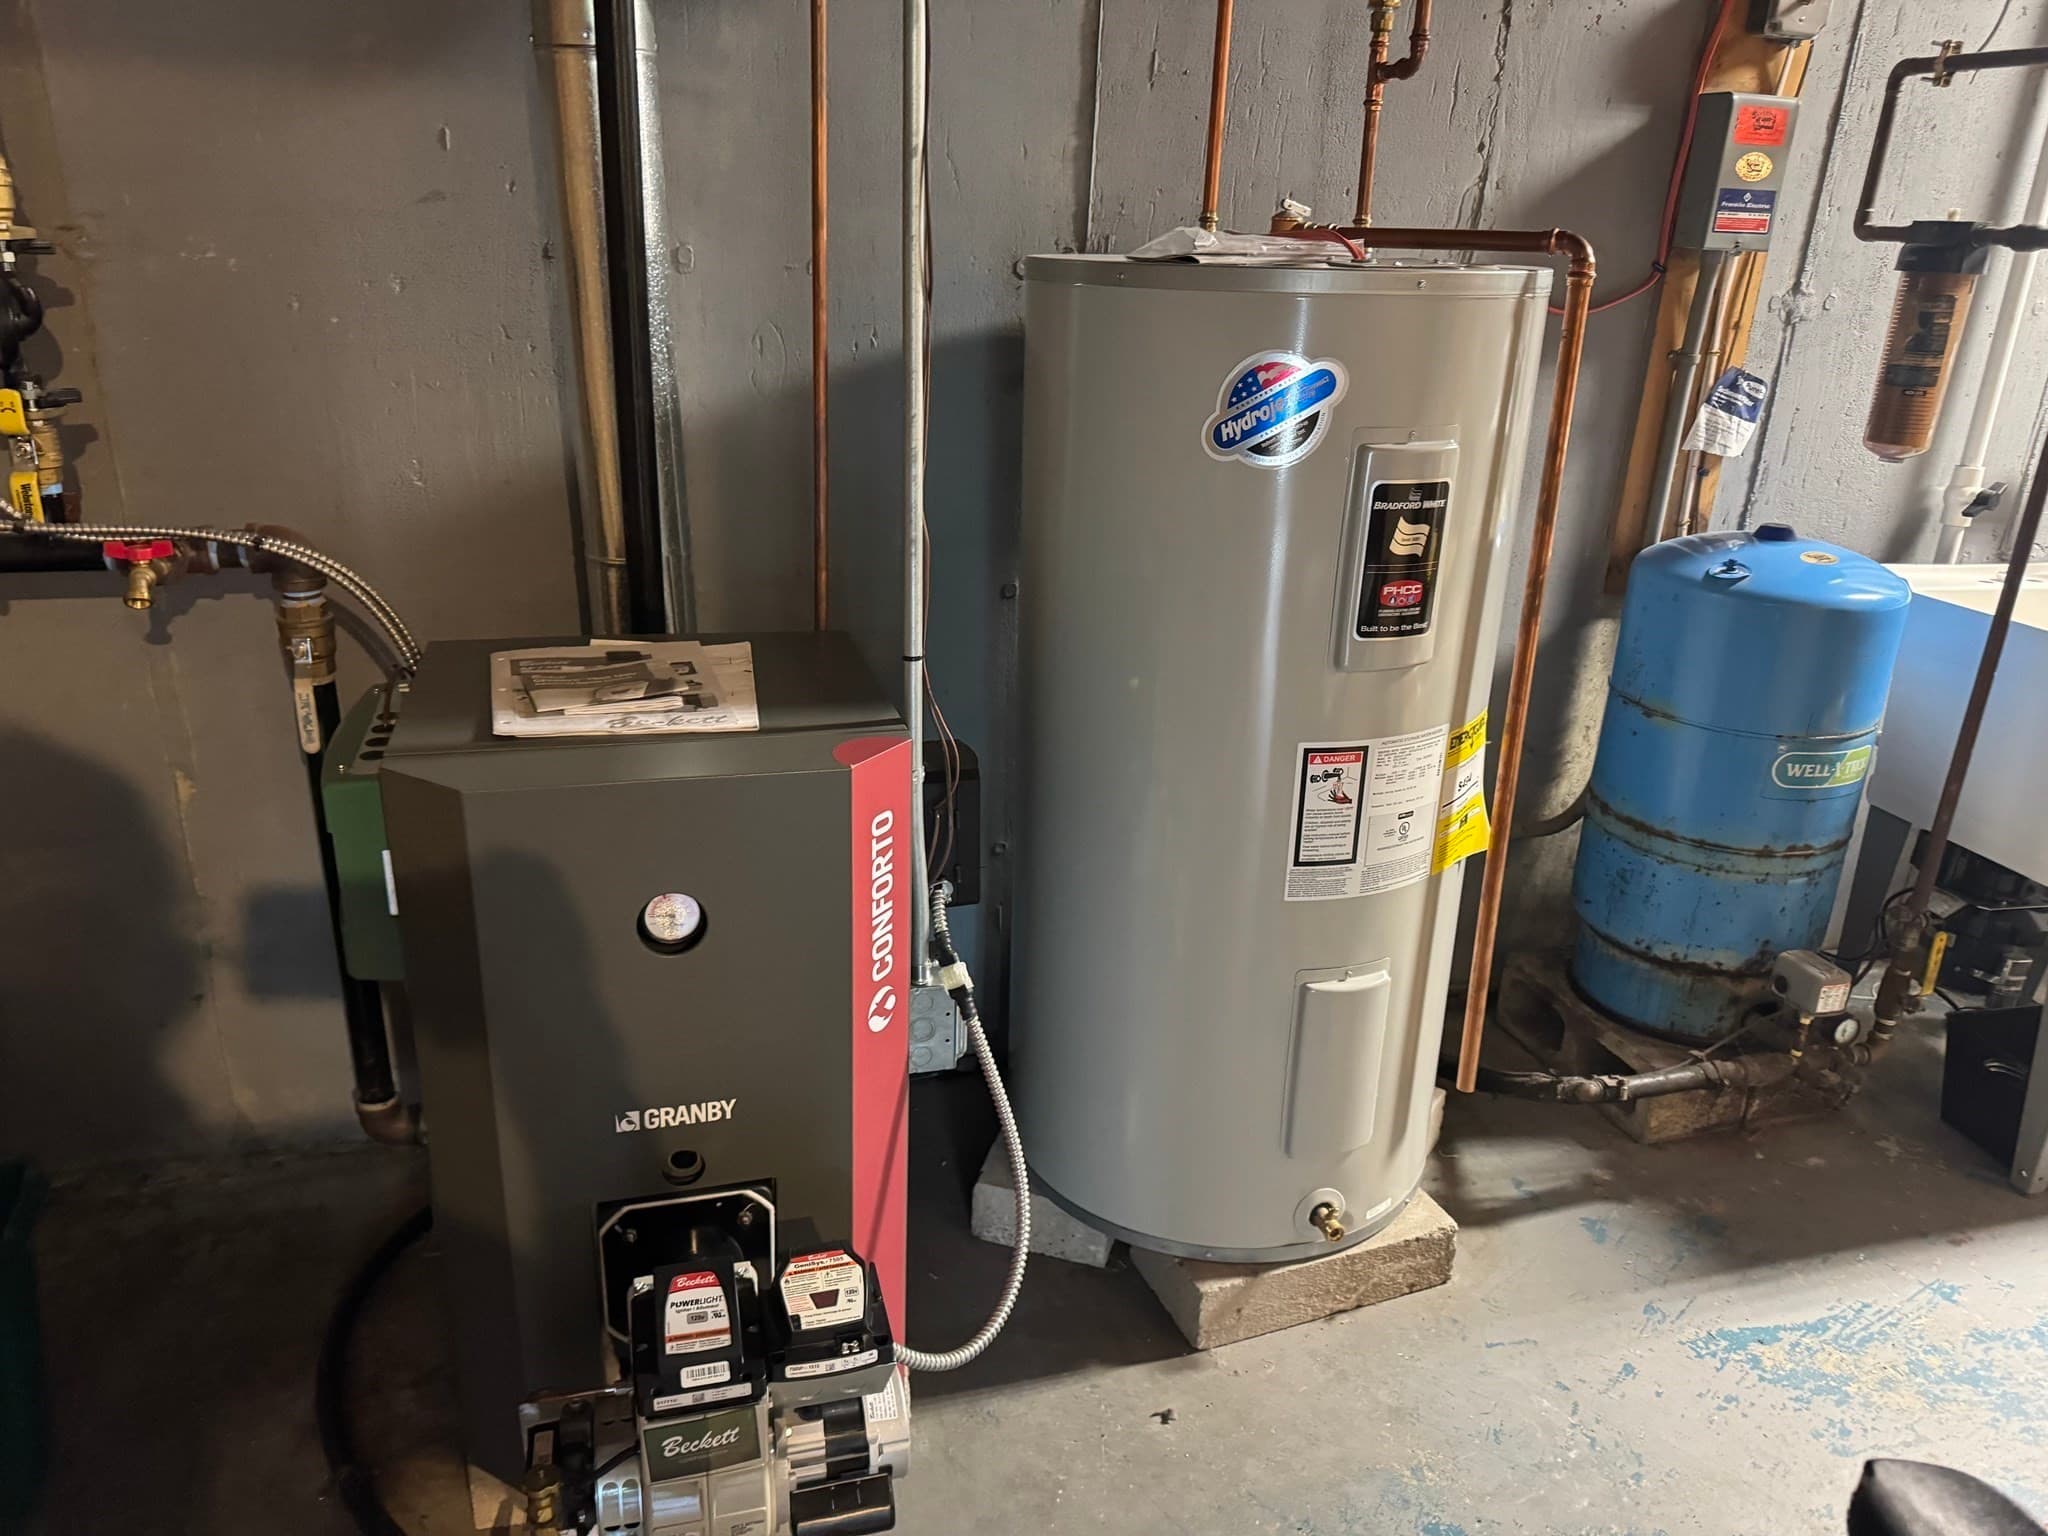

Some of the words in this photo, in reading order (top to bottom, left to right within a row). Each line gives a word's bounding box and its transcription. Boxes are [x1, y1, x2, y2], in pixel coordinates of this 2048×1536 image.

[1220, 393, 1293, 442] Hydroje
[1373, 501, 1422, 510] BRADFORD
[1383, 584, 1423, 596] PHCC
[1323, 755, 1356, 764] DANGER
[871, 809, 894, 982] CONFORTO
[644, 1098, 737, 1130] GRANBY
[676, 1273, 716, 1288] Beckett
[670, 1295, 724, 1309] POWERLIGHT
[661, 1426, 740, 1458] Beckett
